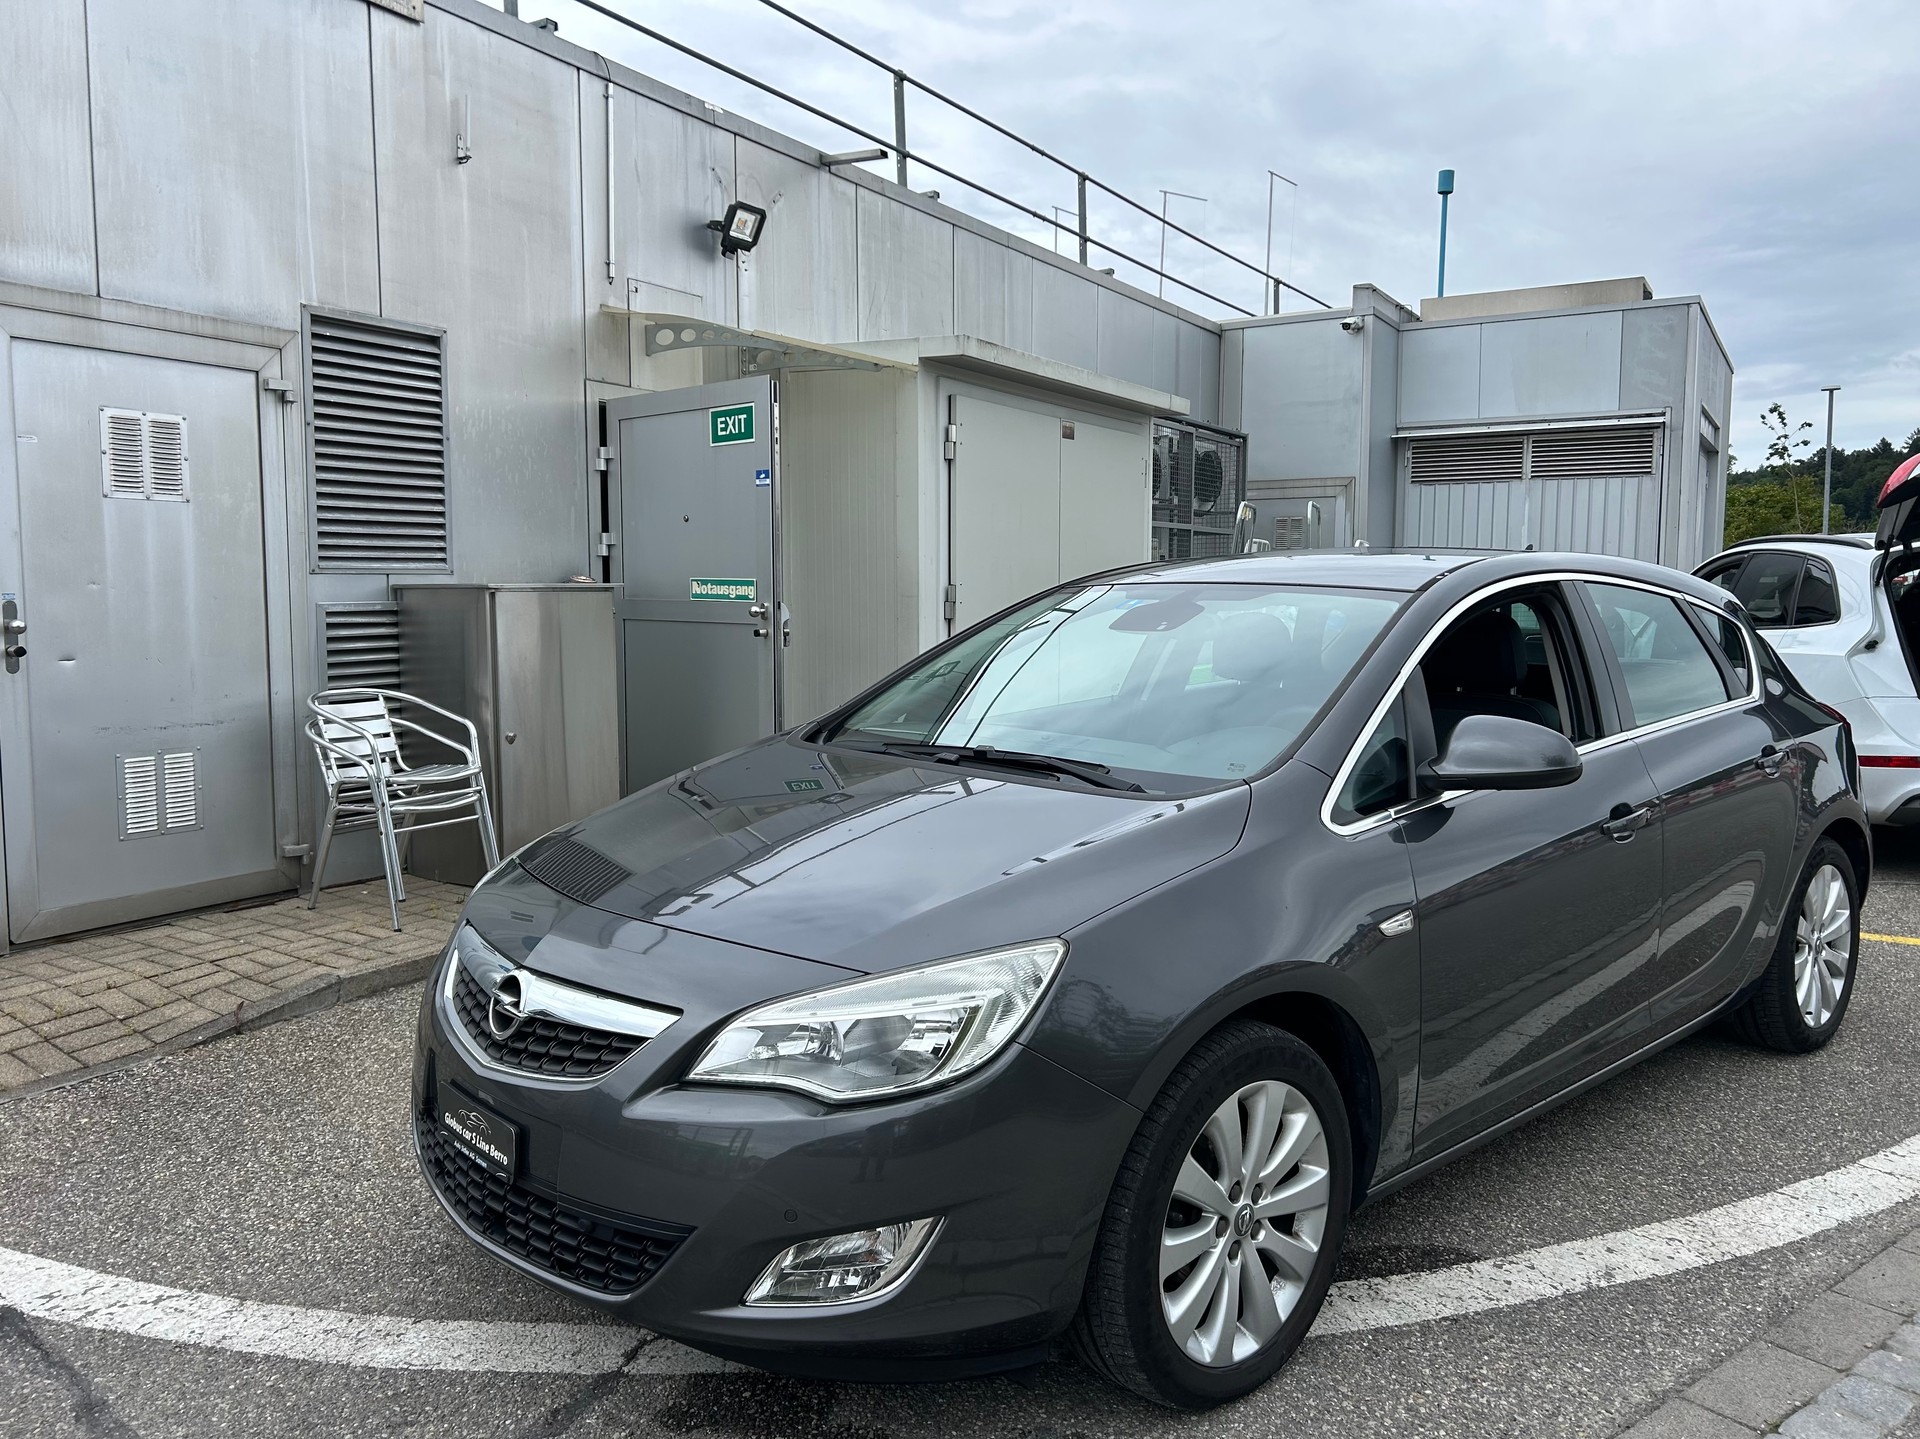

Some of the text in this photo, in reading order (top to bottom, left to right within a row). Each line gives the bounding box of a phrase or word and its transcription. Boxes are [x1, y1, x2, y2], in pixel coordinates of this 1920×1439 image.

[717, 414, 747, 436] EXIT
[692, 581, 754, 599] Notausgang
[444, 1112, 508, 1166] Globus car S Line Berro
